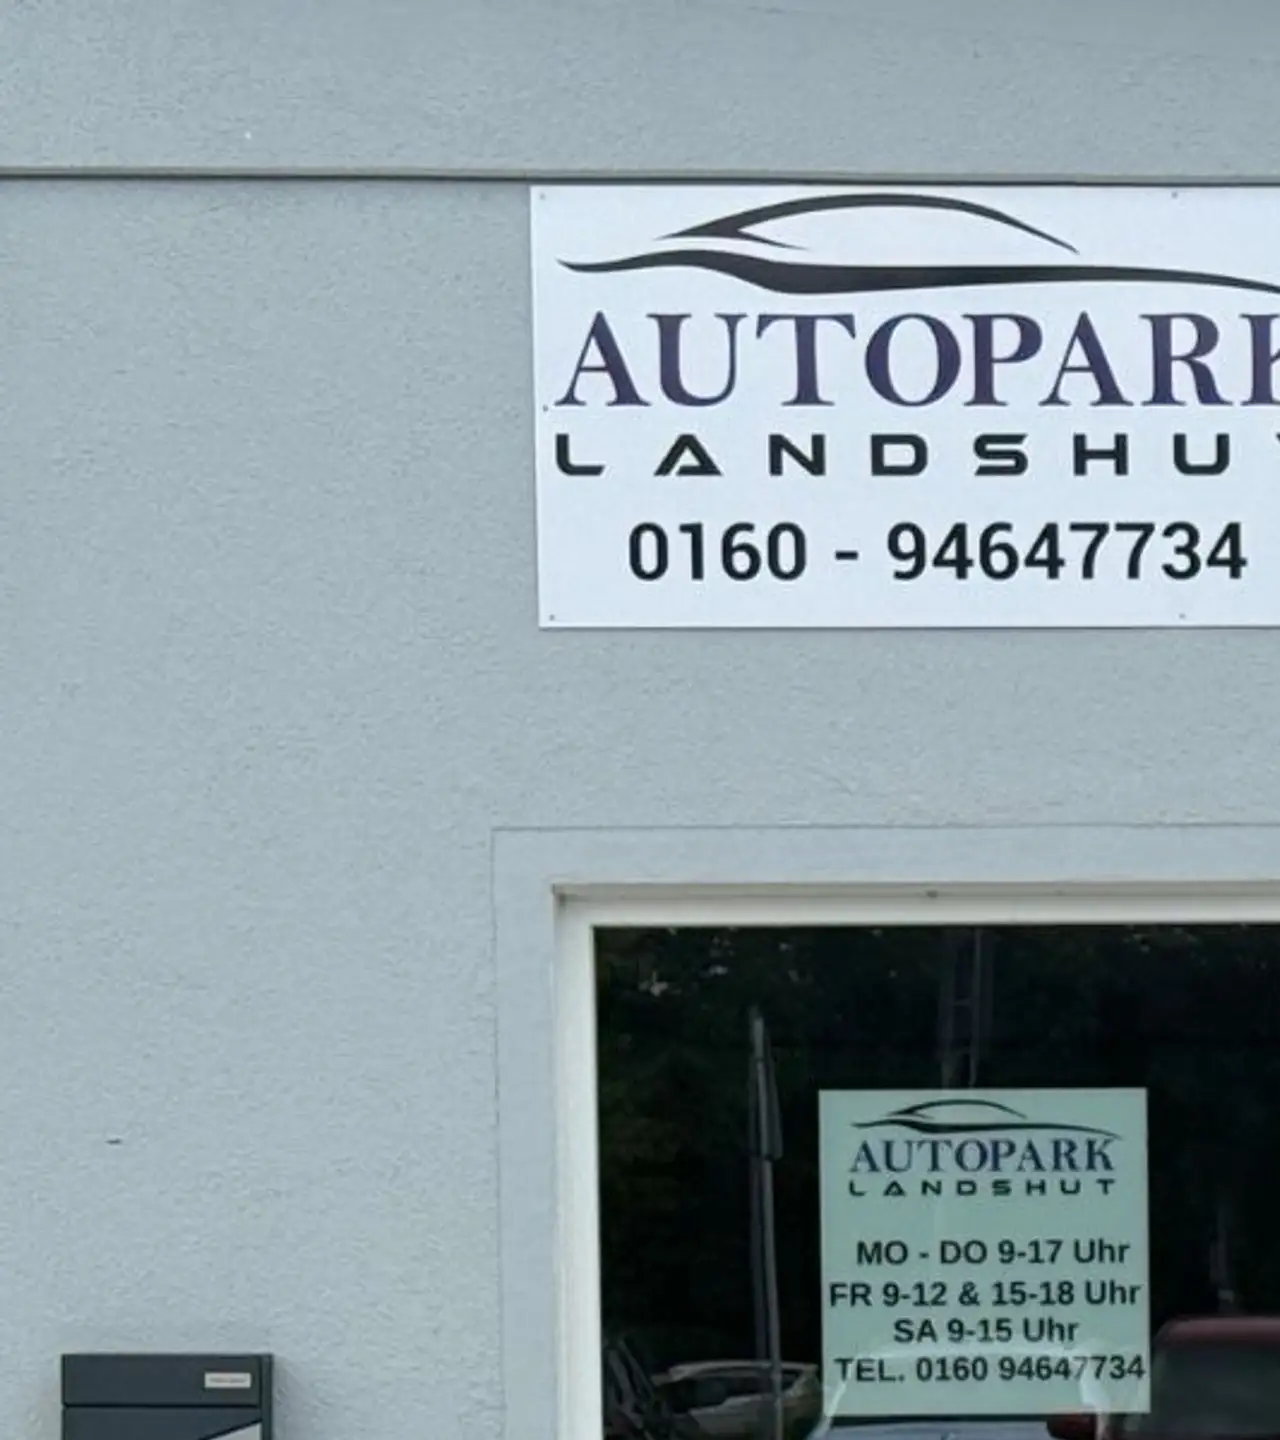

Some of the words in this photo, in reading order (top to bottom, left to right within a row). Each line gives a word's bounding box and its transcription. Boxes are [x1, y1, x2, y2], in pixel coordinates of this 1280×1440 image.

[629, 522, 807, 581] 0160
[834, 550, 859, 561] -
[887, 521, 1248, 581] 94647734
[849, 1138, 1115, 1173] AUTOPARK
[849, 1178, 1116, 1197] LANDSHUT
[856, 1240, 909, 1266] MO
[939, 1239, 988, 1265] DO
[997, 1239, 1063, 1265] 9-17
[1073, 1238, 1131, 1264] Uhr
[829, 1282, 873, 1307] FR
[882, 1281, 947, 1308] 9-12
[958, 1281, 981, 1307] &
[991, 1280, 1075, 1307] 15-18
[1085, 1279, 1142, 1305] Uhr
[893, 1318, 937, 1343] SA
[946, 1317, 1013, 1343] 9-15
[1022, 1316, 1080, 1343] Uhr
[833, 1357, 905, 1383] TEL.
[916, 1356, 989, 1382] 0160
[998, 1354, 1146, 1382] 94647734
